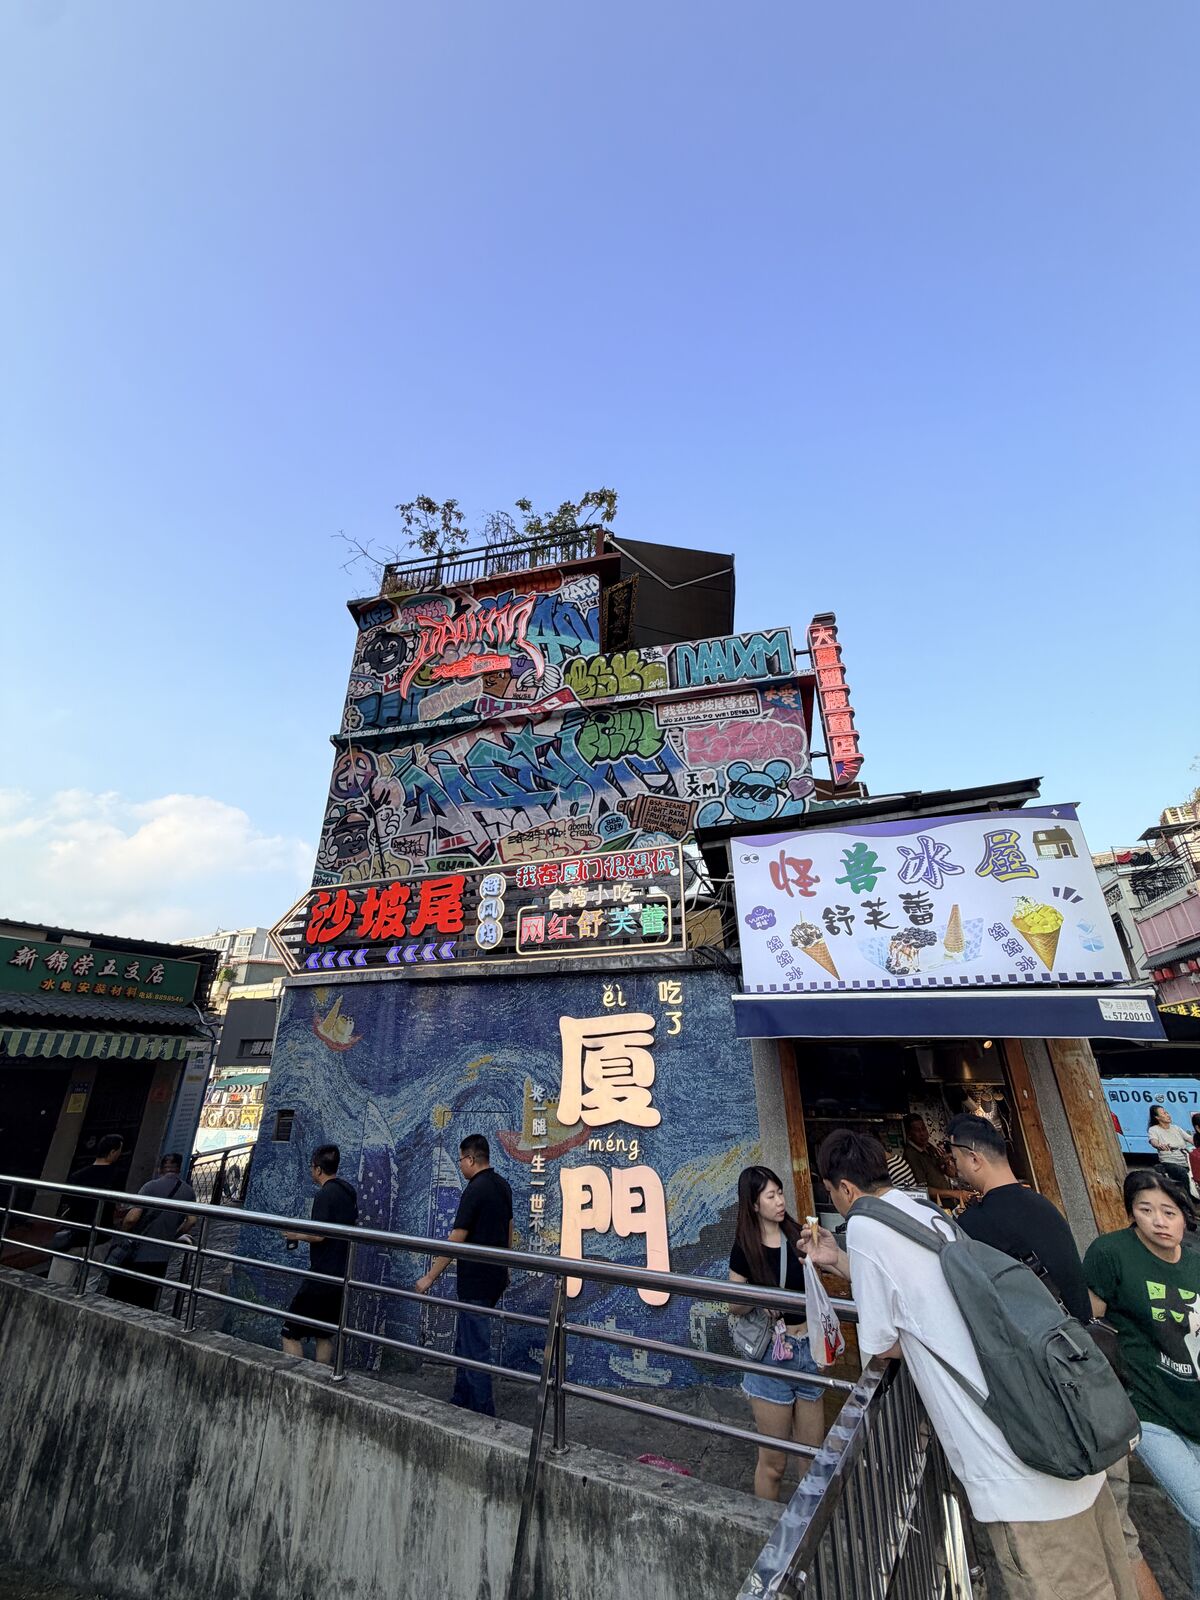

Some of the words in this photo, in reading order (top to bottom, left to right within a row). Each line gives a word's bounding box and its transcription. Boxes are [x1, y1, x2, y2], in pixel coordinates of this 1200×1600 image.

[662, 694, 756, 718] 我在沙坡尾等你
[687, 782, 716, 798] XM
[515, 849, 675, 889] 我在厦门很想你
[769, 829, 1040, 899] 怪兽冰屋
[306, 875, 468, 945] 沙坡尾
[548, 881, 635, 911] 台湾小吃
[822, 890, 935, 937] 舒芙蕾
[520, 904, 667, 945] 网红舒芙蕾
[658, 980, 683, 1035] 吃了
[1112, 1011, 1152, 1021] 5720010
[557, 1012, 661, 1127] 厦
[588, 1131, 641, 1161] méng
[527, 1084, 548, 1279] 来一腿一生一世不出
